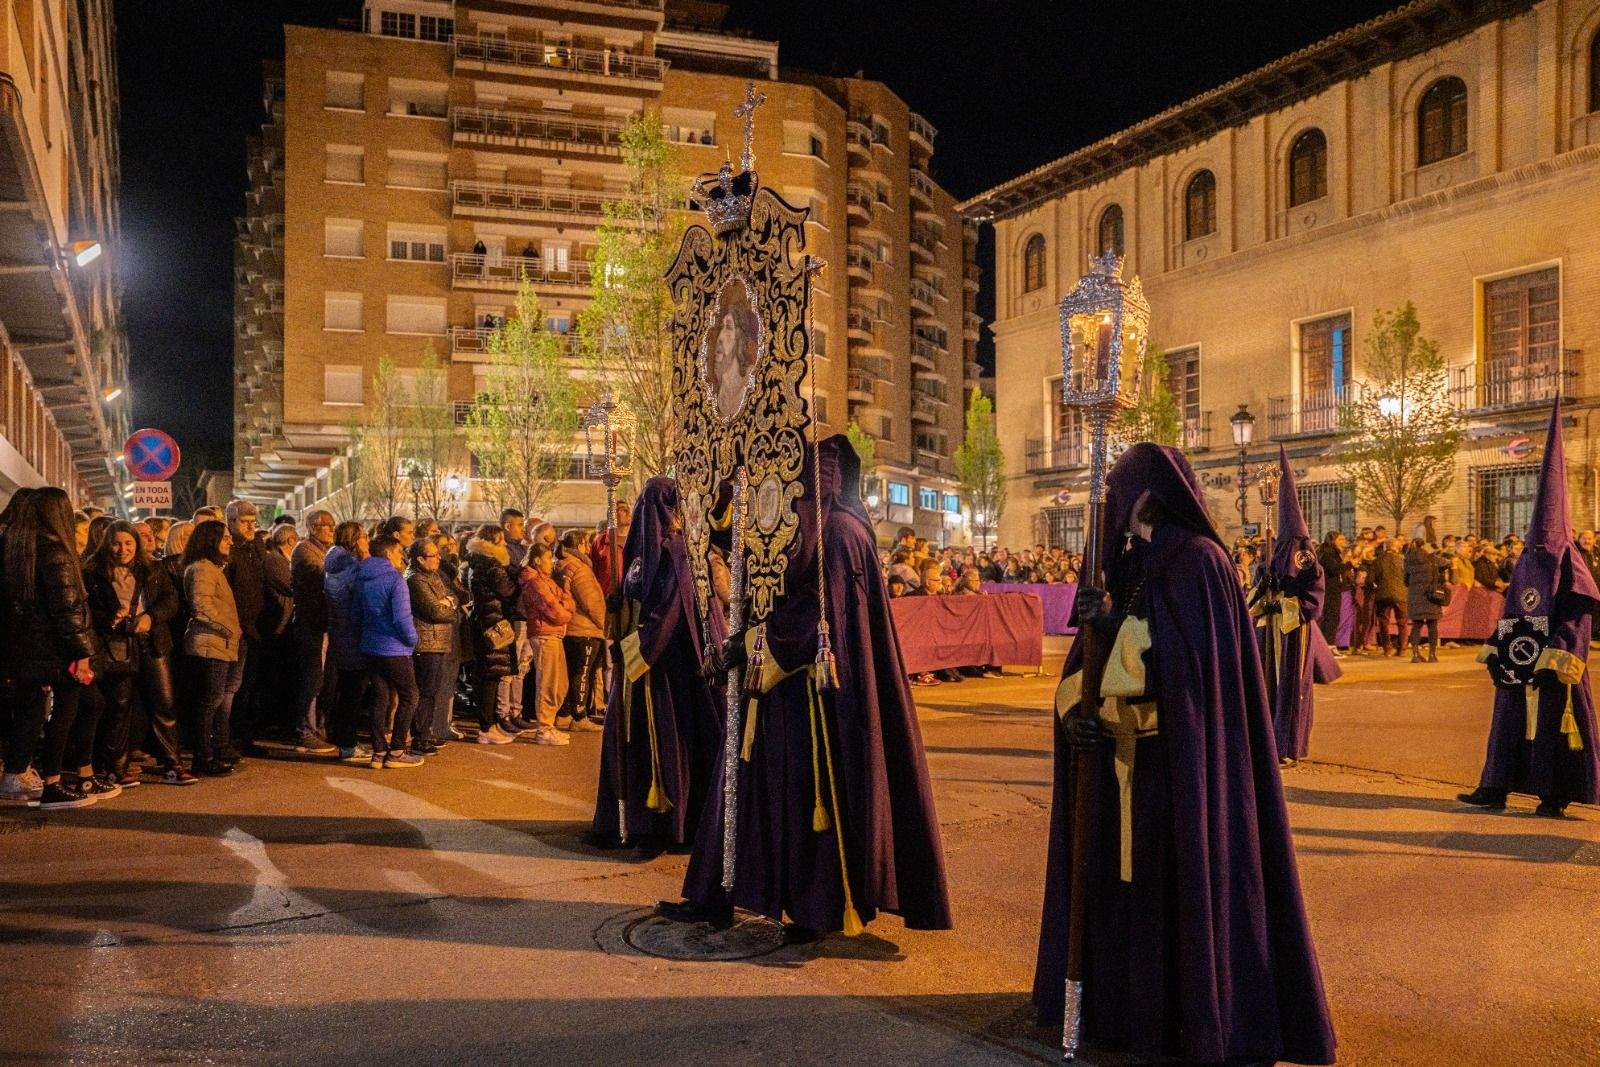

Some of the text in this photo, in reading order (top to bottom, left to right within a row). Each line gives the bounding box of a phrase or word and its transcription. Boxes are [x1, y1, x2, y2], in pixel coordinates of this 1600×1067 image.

[147, 486, 168, 494] TODA
[135, 496, 170, 504] LA PLAZA
[580, 646, 593, 702] WITCHY
